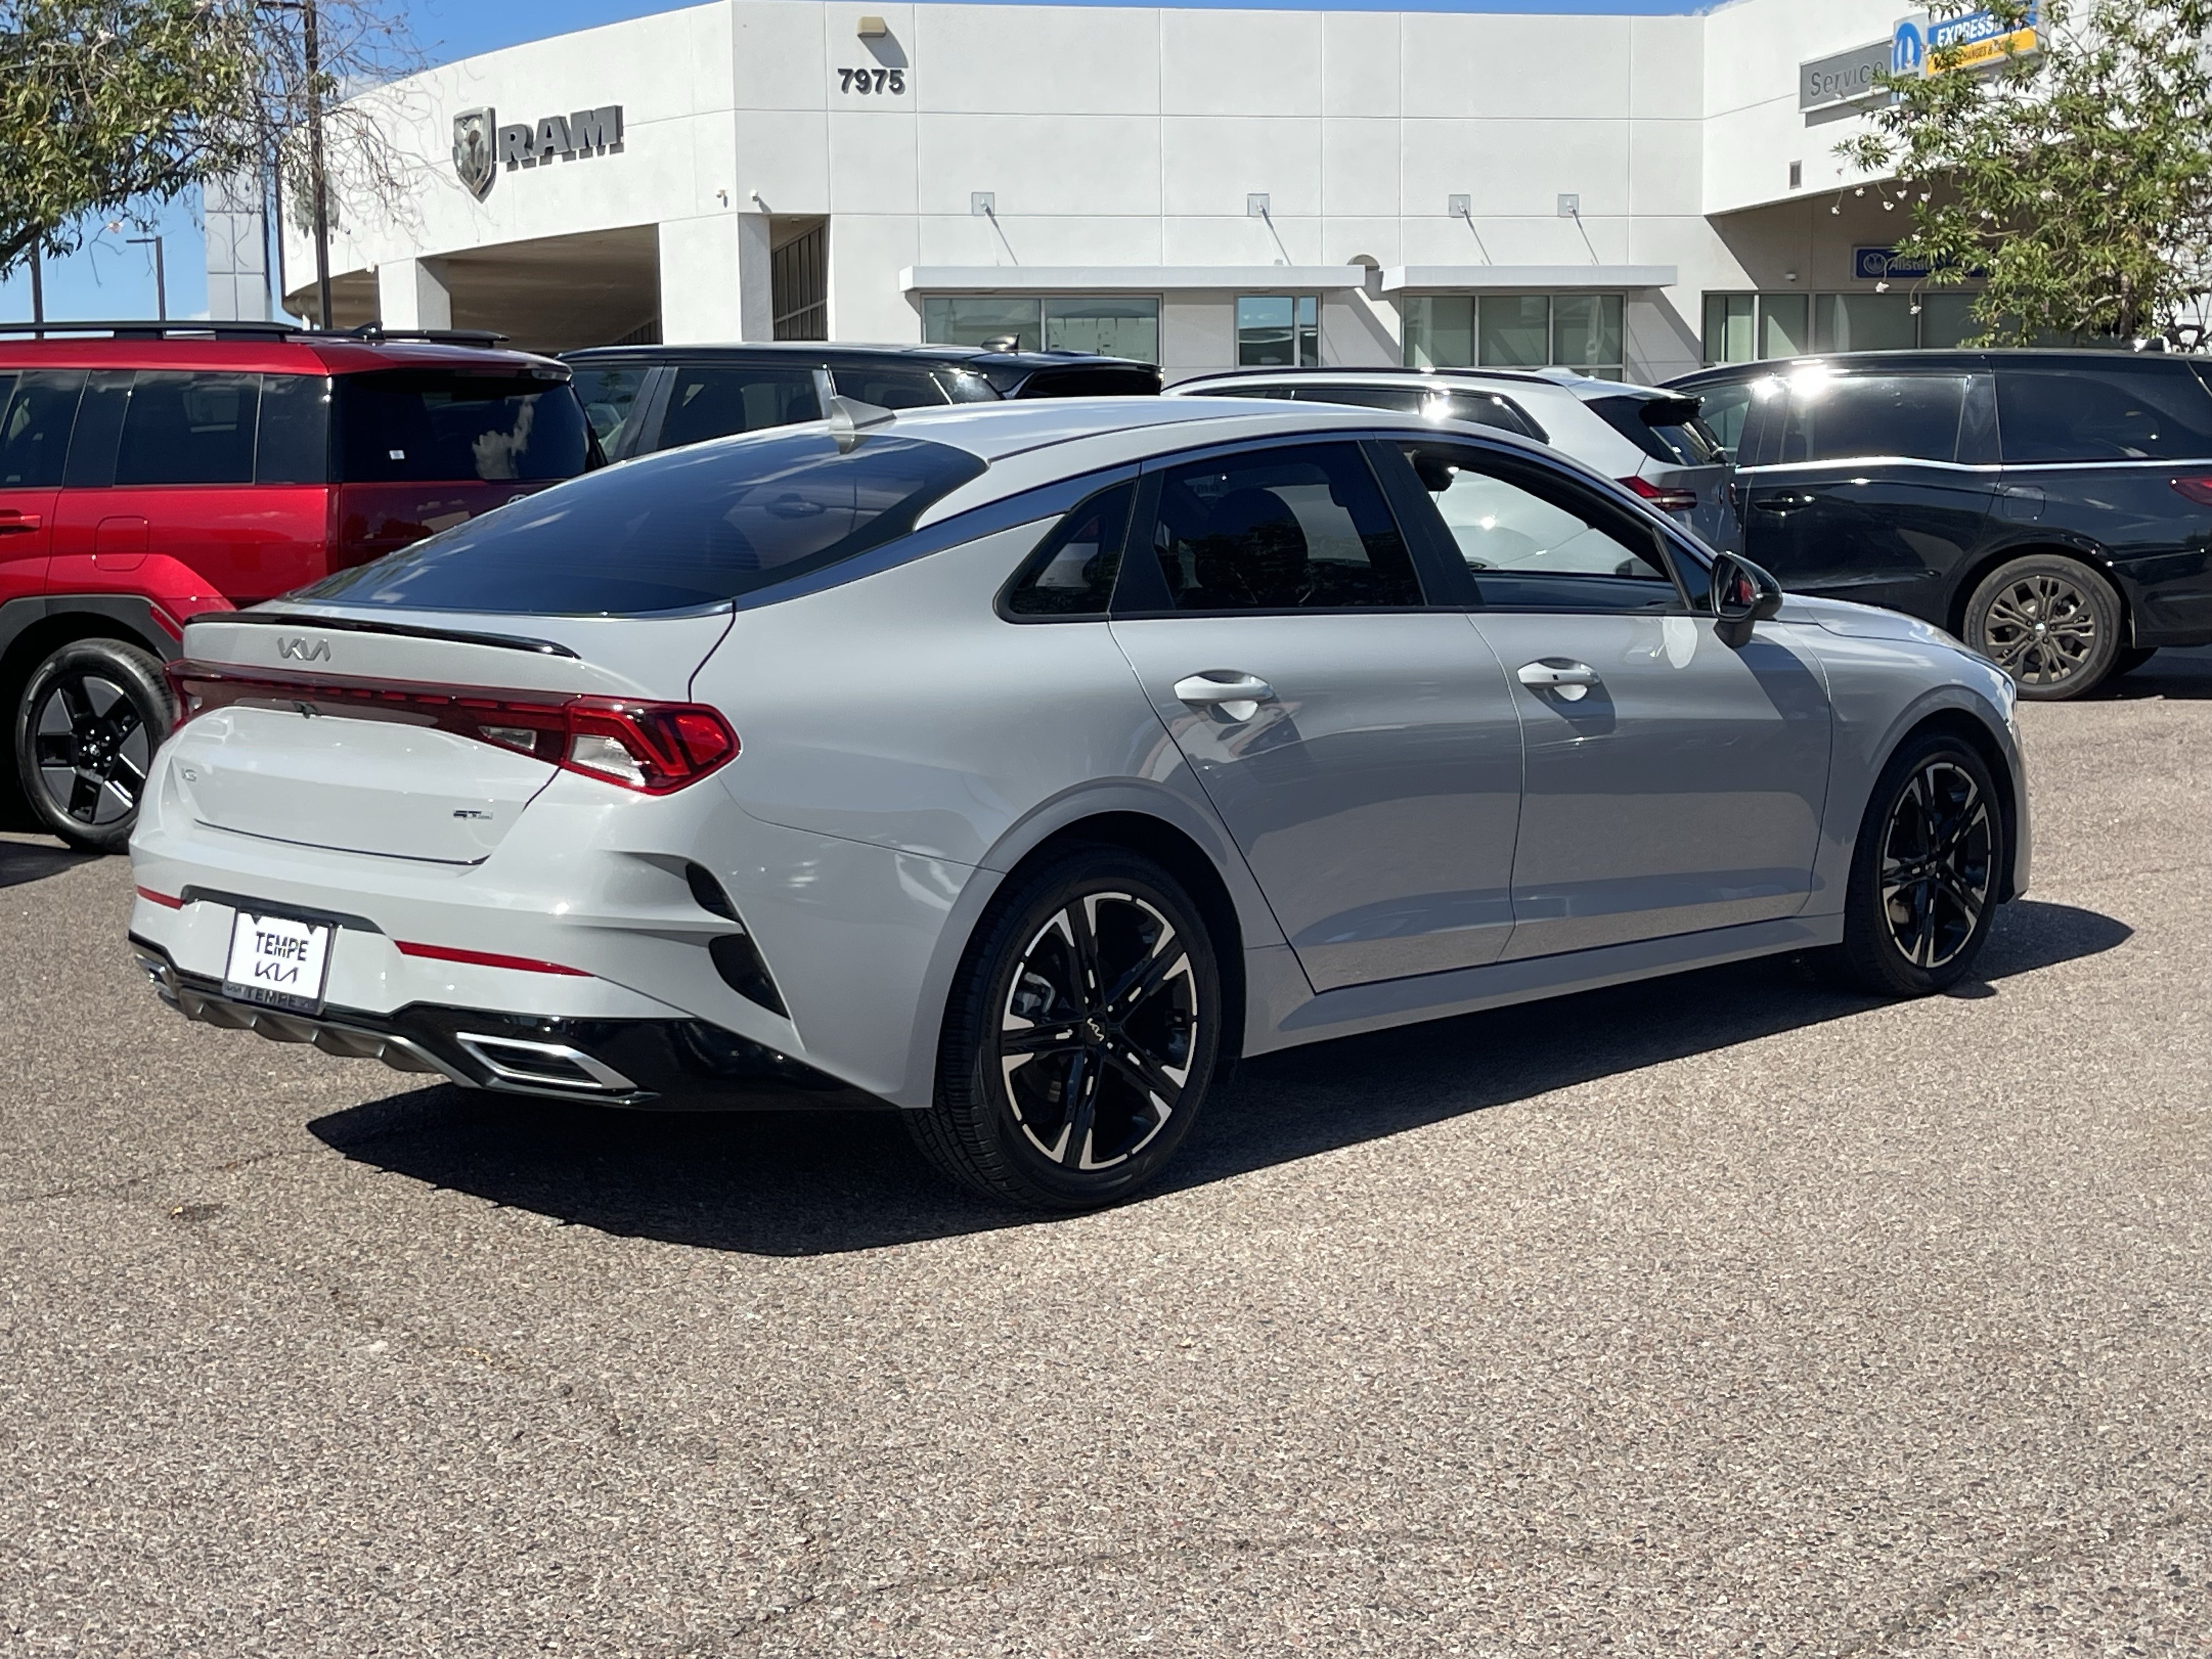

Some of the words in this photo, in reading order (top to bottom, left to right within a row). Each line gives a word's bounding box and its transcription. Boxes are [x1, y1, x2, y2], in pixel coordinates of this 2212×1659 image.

[1937, 14, 1995, 47] EXPRESS
[1961, 46, 1987, 62] HANGES
[838, 68, 905, 95] 7975
[498, 105, 623, 163] RAM
[277, 637, 331, 662] KIA
[255, 930, 309, 962] TEMPE
[255, 961, 299, 984] KIA
[247, 986, 297, 1008] TEMPE
